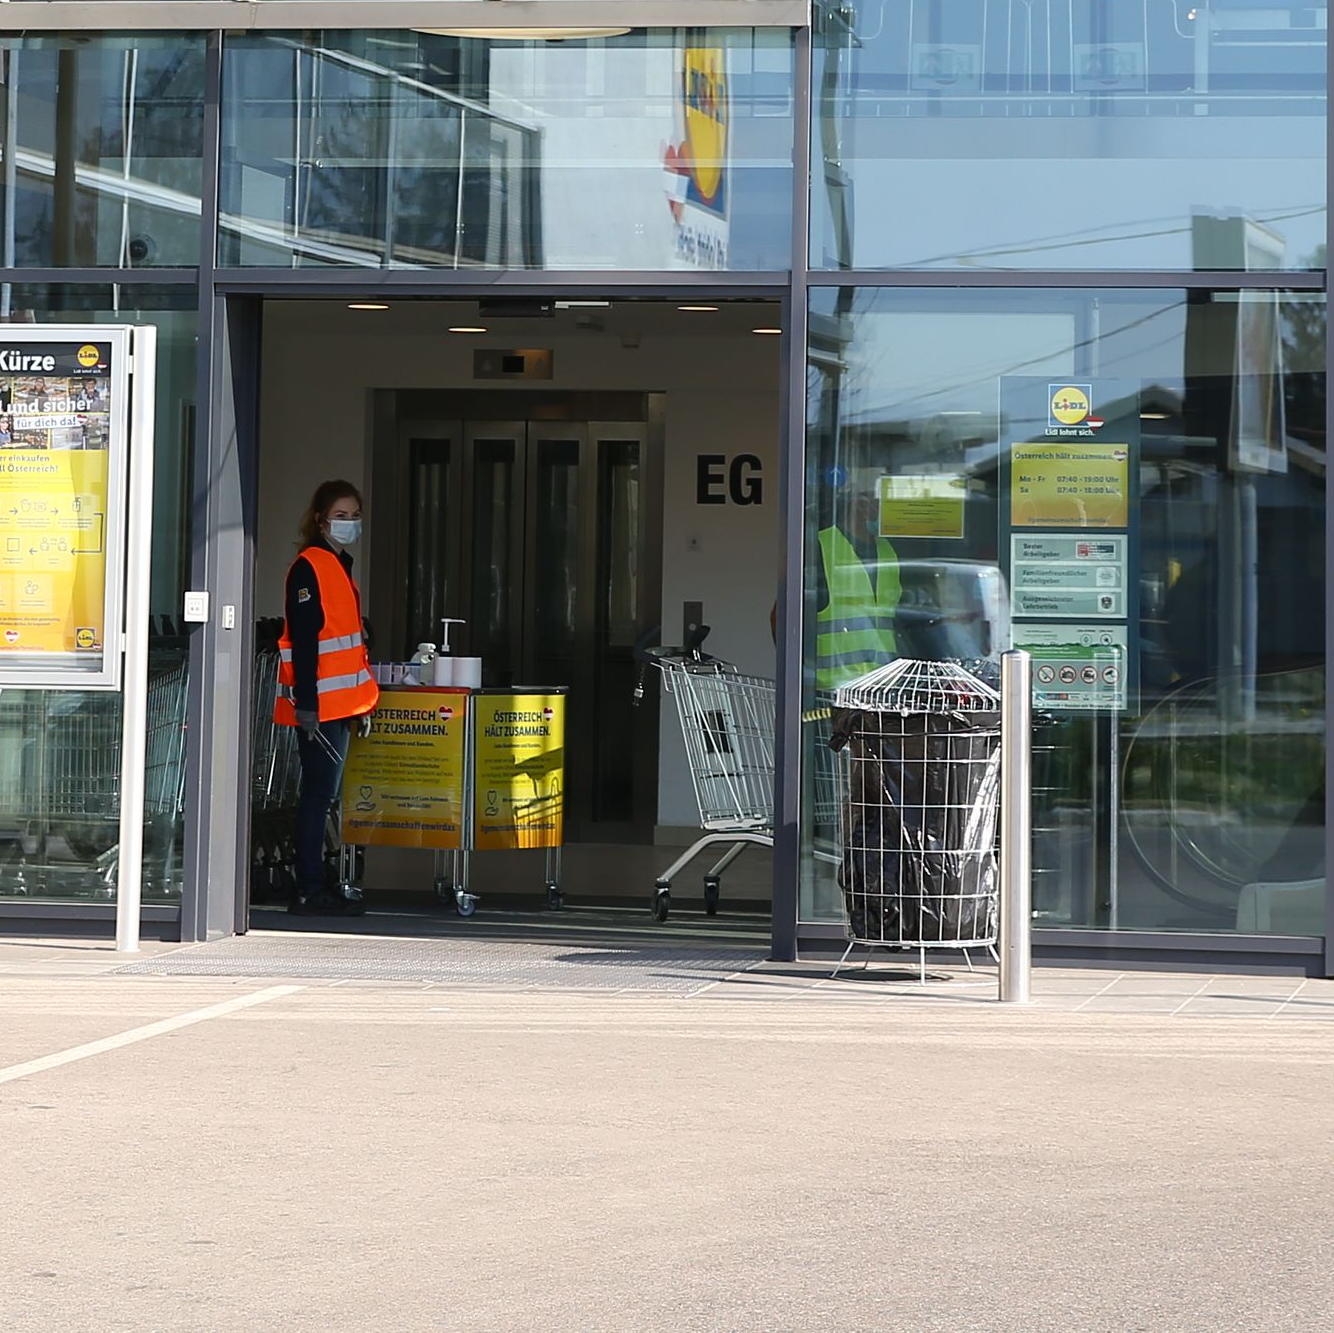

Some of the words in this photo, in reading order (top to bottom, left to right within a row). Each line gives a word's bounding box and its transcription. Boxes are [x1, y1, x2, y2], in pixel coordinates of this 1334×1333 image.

[7, 399, 39, 414] und
[42, 397, 93, 412] sicher
[17, 419, 31, 428] für
[37, 418, 57, 427] dich
[60, 416, 76, 426] da!
[8, 454, 50, 462] einkaufen
[1014, 451, 1054, 460] Österreich
[7, 463, 58, 473] Österreich!
[696, 454, 763, 505] EG
[493, 710, 542, 723] ÖSTERREICH
[383, 723, 448, 736] ZUSAMMEN.
[484, 724, 502, 737] HÄLT
[503, 724, 551, 737] ZUSAMMEN.
